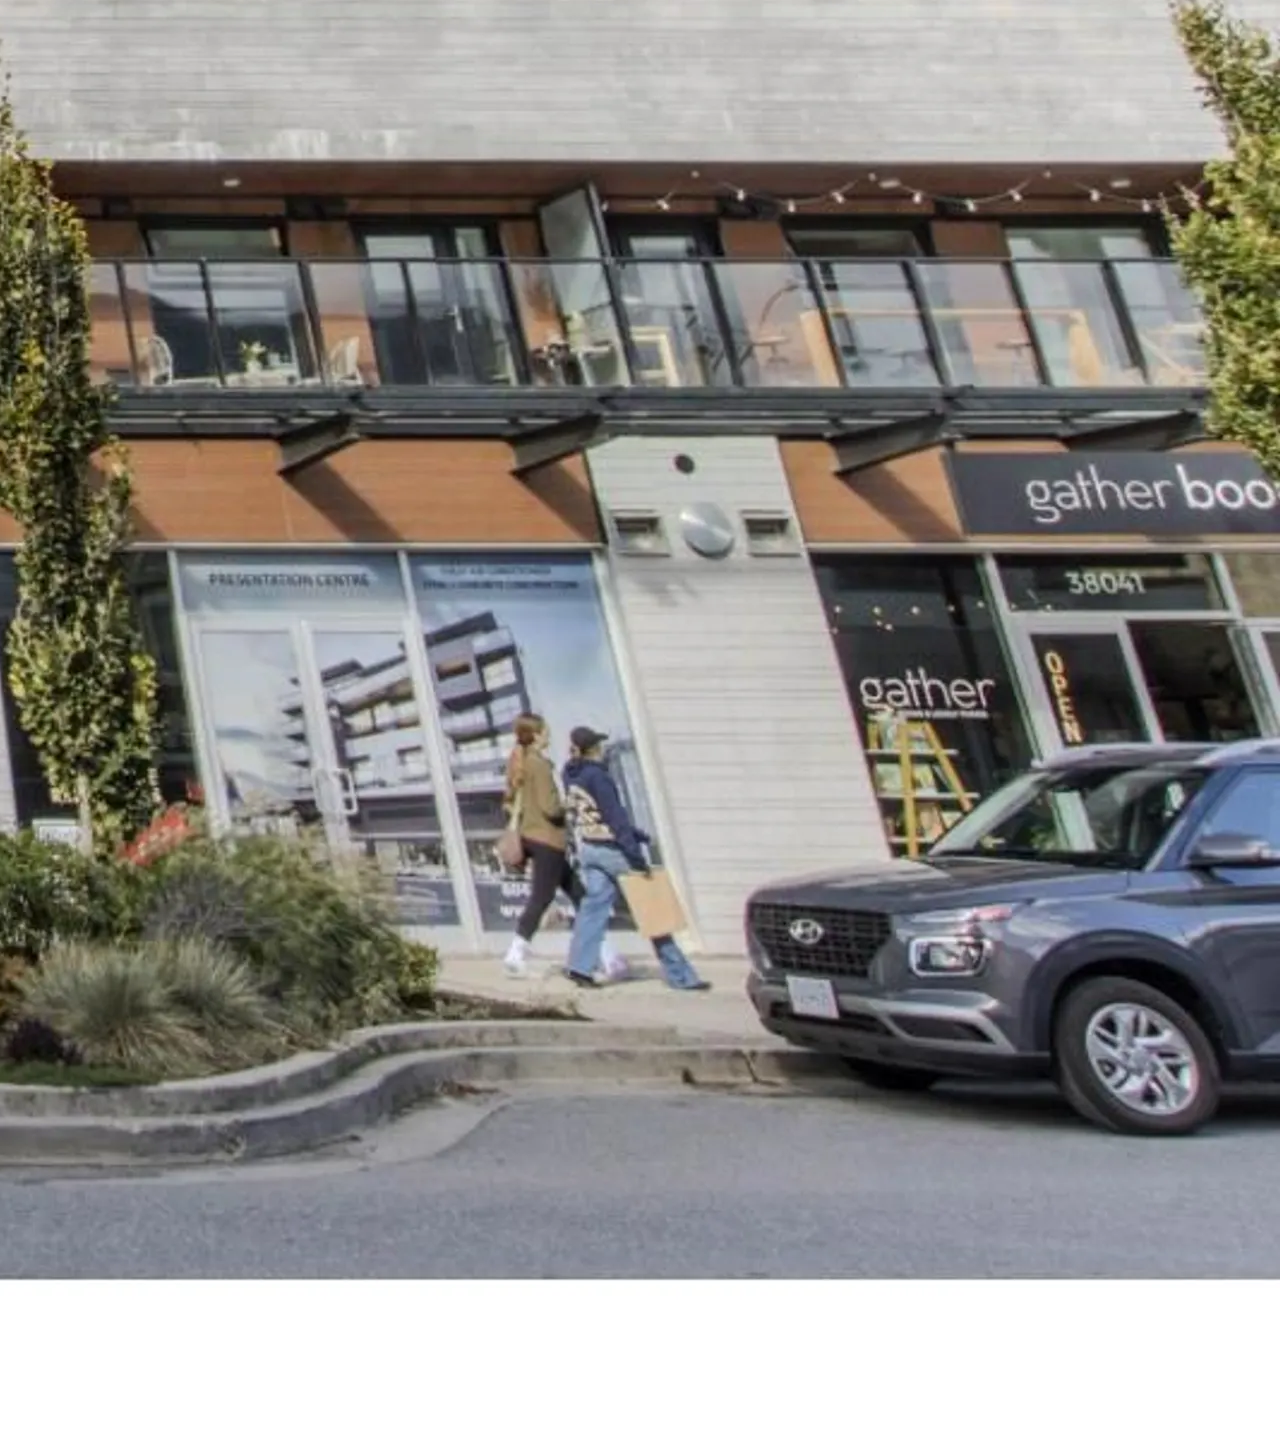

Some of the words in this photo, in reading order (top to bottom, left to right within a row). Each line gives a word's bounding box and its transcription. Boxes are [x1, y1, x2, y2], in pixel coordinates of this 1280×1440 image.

[1025, 463, 1174, 523] gather
[1175, 463, 1280, 509] boo
[208, 573, 313, 587] PRESENTATION
[316, 573, 371, 587] CENTRE
[1064, 571, 1146, 594] 38041
[859, 666, 995, 712] gather
[1045, 651, 1082, 742] OPEN
